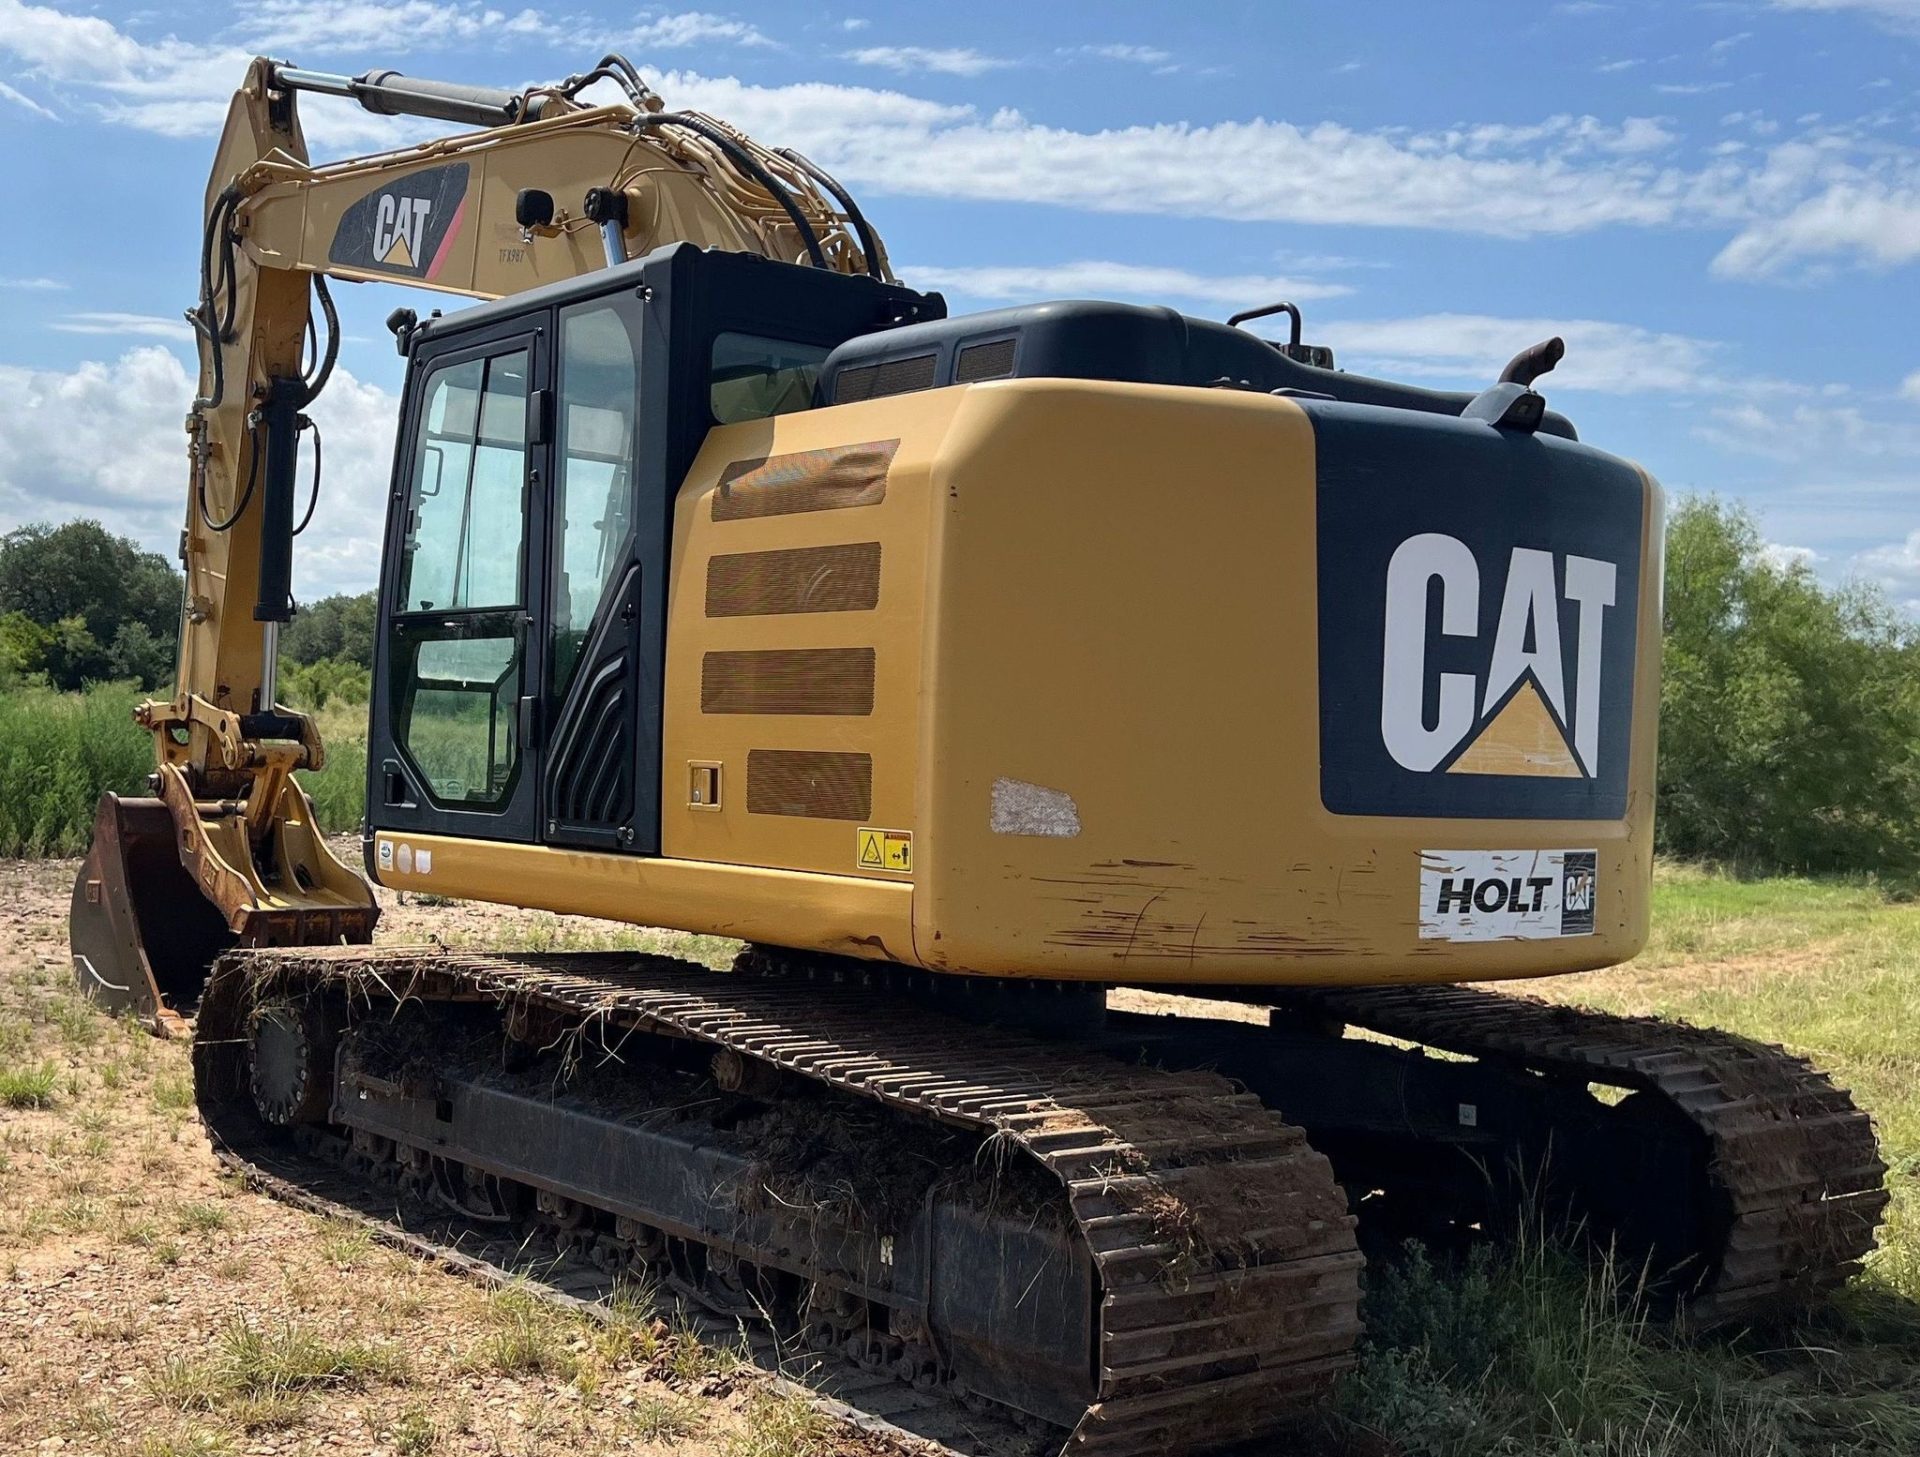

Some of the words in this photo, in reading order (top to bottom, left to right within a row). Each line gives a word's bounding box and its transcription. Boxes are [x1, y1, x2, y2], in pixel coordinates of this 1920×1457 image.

[373, 194, 431, 268] CAT
[1381, 533, 1617, 778] CAT
[1437, 877, 1553, 914] HOLT
[1566, 876, 1593, 911] CAT
